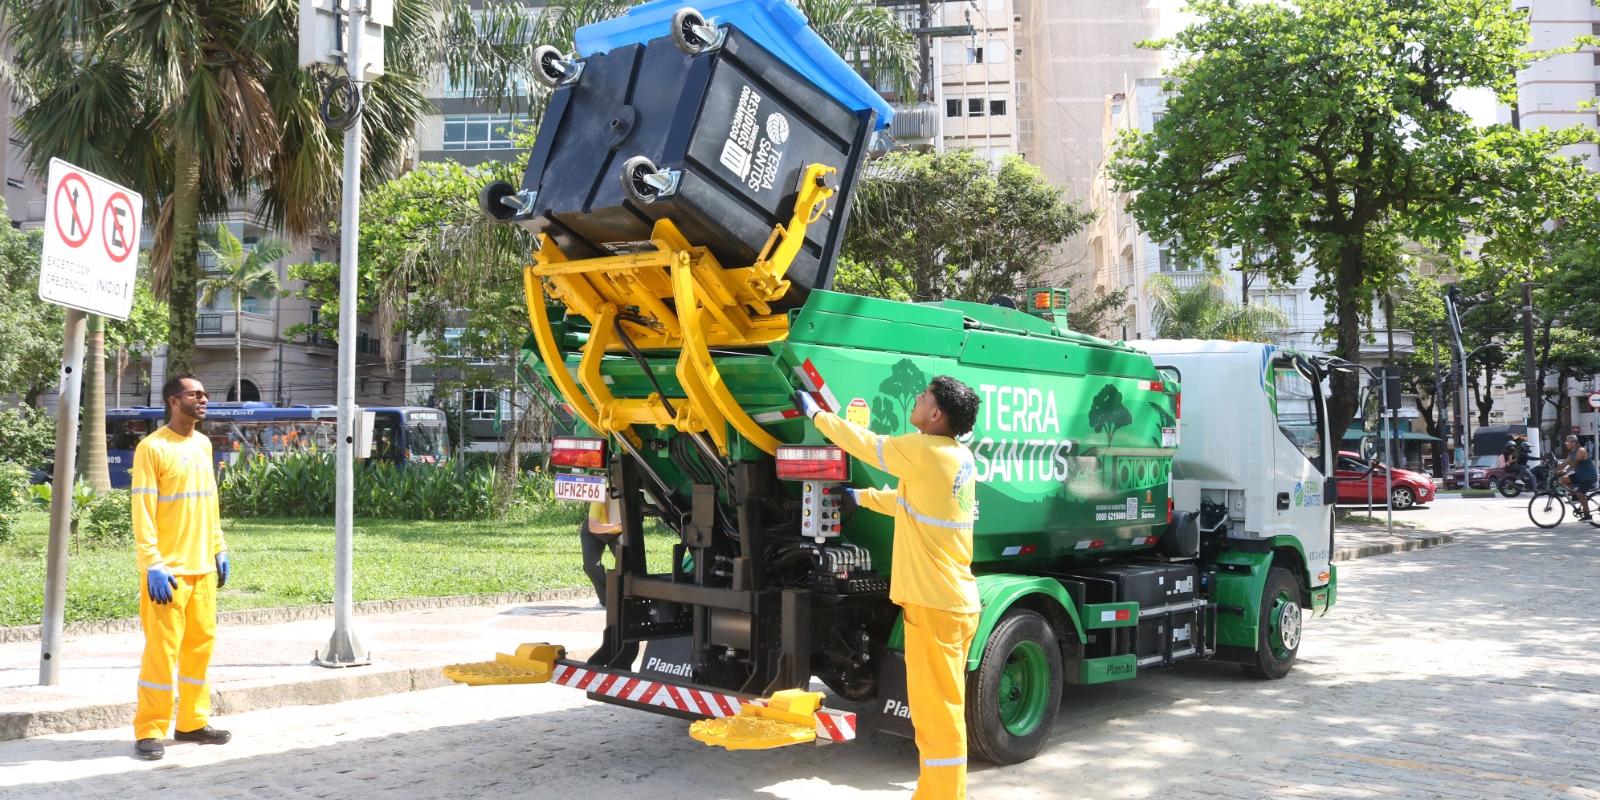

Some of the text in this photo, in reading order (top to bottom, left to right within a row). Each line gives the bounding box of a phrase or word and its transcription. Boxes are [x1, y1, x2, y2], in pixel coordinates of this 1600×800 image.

[749, 138, 771, 192] SANTOS
[761, 148, 782, 190] TERRA
[47, 255, 74, 272] EXCETO
[979, 383, 1060, 433] TERRA
[973, 436, 1073, 482] SANTOS
[558, 482, 600, 499] UFN2F66
[1304, 494, 1321, 507] SANTOS
[883, 699, 911, 719] Pla
